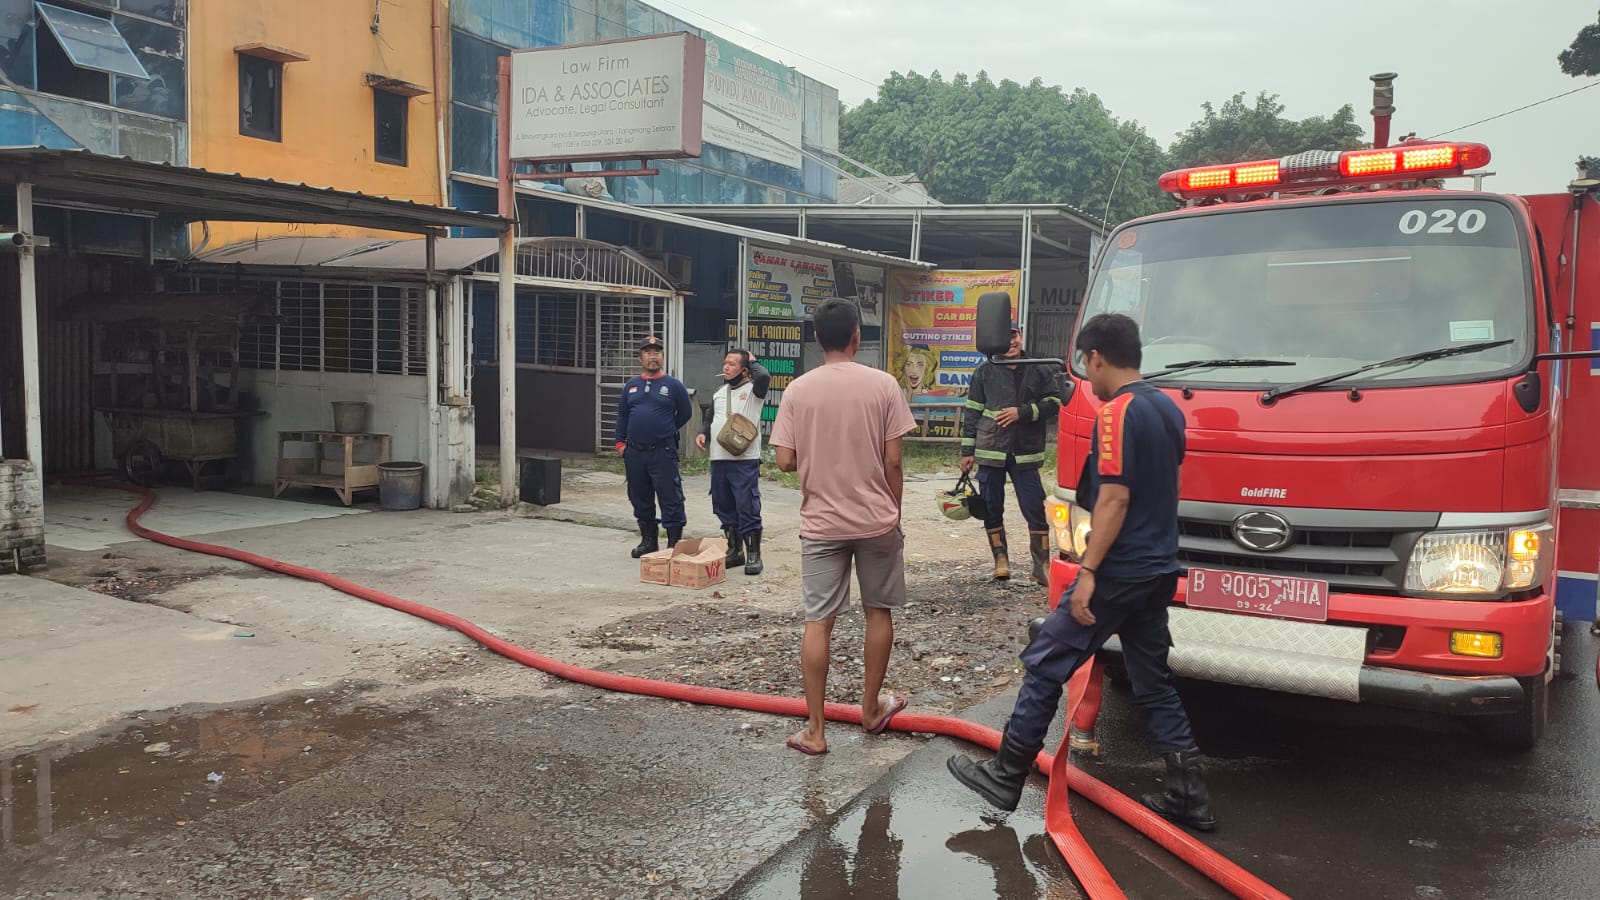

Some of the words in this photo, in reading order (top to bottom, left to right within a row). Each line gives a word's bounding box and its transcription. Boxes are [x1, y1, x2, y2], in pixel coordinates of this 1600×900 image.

[562, 60, 591, 74] Law
[598, 57, 629, 71] Firm
[522, 87, 548, 105] IDA
[554, 85, 565, 102] &
[571, 75, 669, 100] ASSOCIATES
[706, 71, 740, 101] PUNDI
[525, 104, 576, 118] Advocate,
[580, 101, 607, 116] Legal
[609, 98, 664, 112] Consultant
[1398, 208, 1486, 235] 020
[903, 290, 955, 302] STIKER
[1041, 287, 1085, 306] MUL
[936, 313, 957, 321] CAR
[762, 325, 801, 340] PRINTING
[902, 332, 940, 341] CUTTING
[942, 333, 972, 341] STIKER
[770, 341, 801, 358] STIKER
[941, 355, 981, 365] oneway
[1240, 487, 1287, 499] GoldFIRE
[705, 560, 721, 579] Vit
[1193, 570, 1206, 593] B
[1221, 573, 1270, 599] 9005
